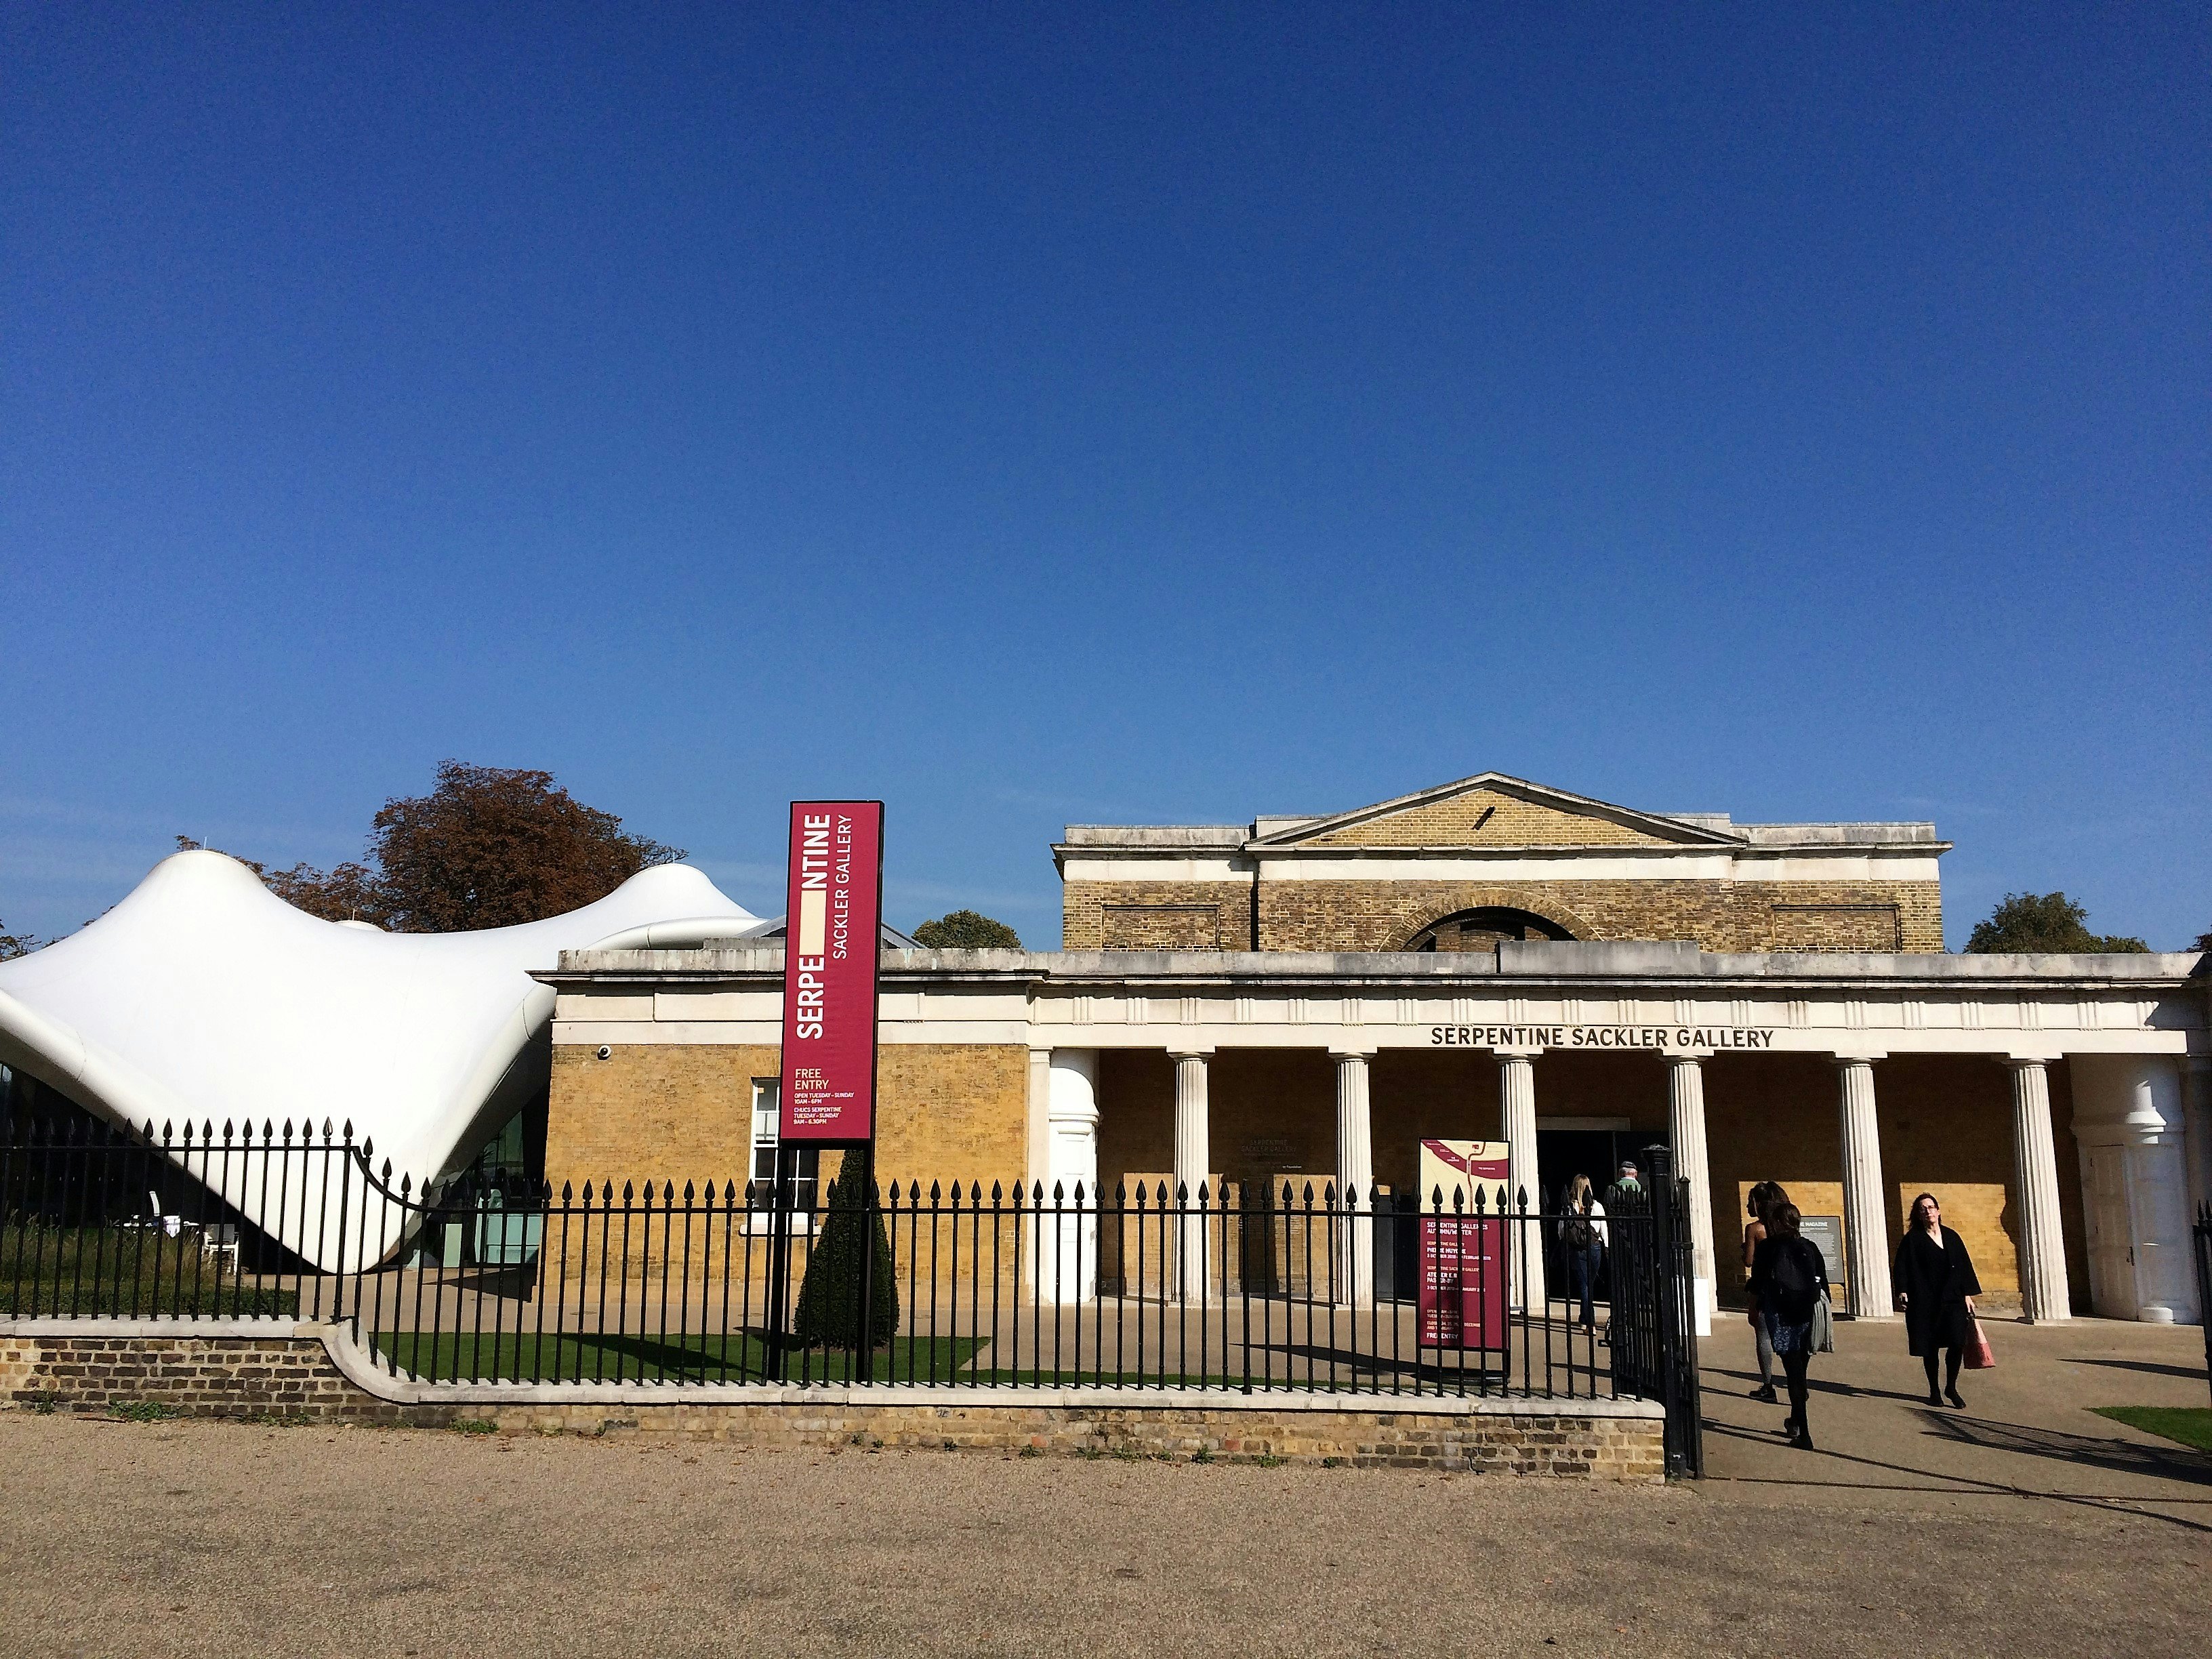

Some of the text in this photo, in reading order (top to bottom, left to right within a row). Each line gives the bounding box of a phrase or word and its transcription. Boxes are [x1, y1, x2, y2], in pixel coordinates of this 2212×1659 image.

[832, 814, 853, 959] SACKLER GALLERY
[1431, 1027, 1774, 1047] SERPENTINE SACKLER GALLERY
[795, 1069, 822, 1078] FREE
[795, 1080, 829, 1090] ENTRY
